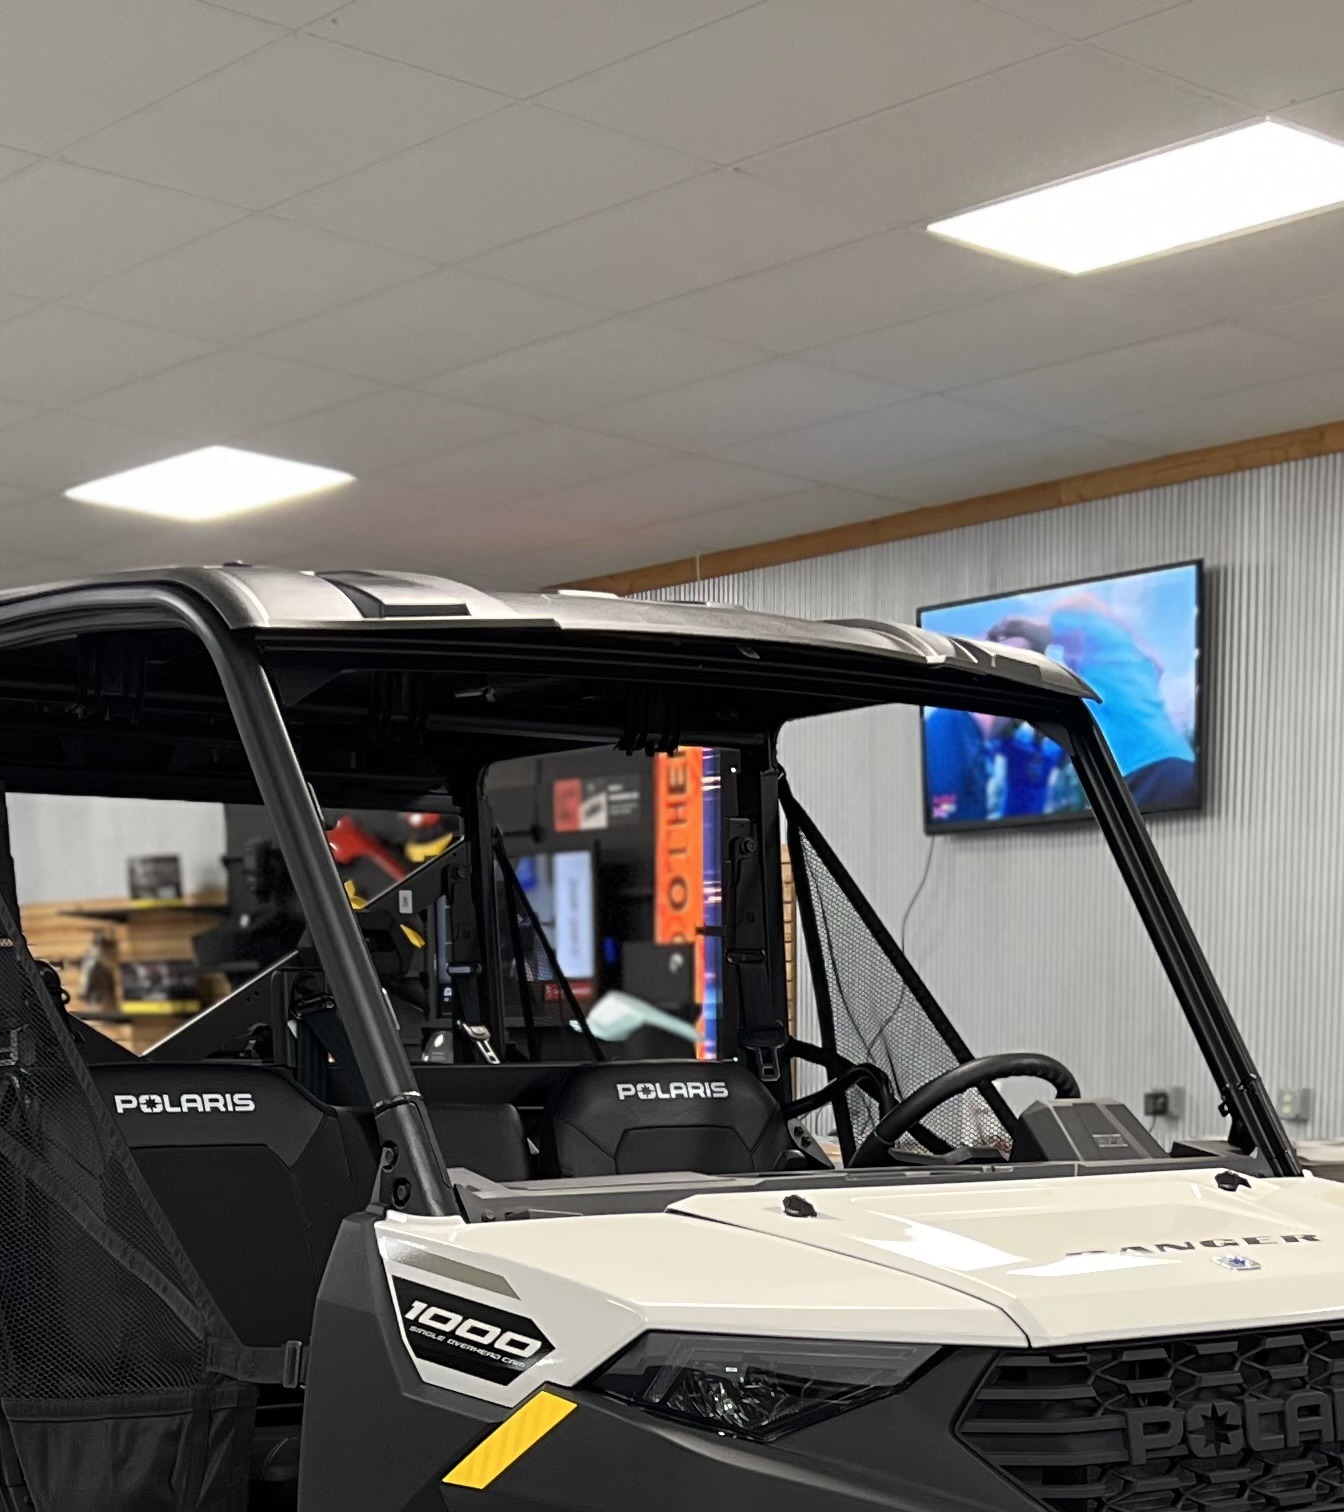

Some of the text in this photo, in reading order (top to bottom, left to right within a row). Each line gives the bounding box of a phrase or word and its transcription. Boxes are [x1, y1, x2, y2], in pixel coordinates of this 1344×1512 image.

[114, 1093, 256, 1113] POLARIS
[616, 1082, 729, 1101] POLARIS
[404, 1300, 543, 1359] 1000
[409, 1325, 526, 1368] SINGLE OVERHEAD CAM
